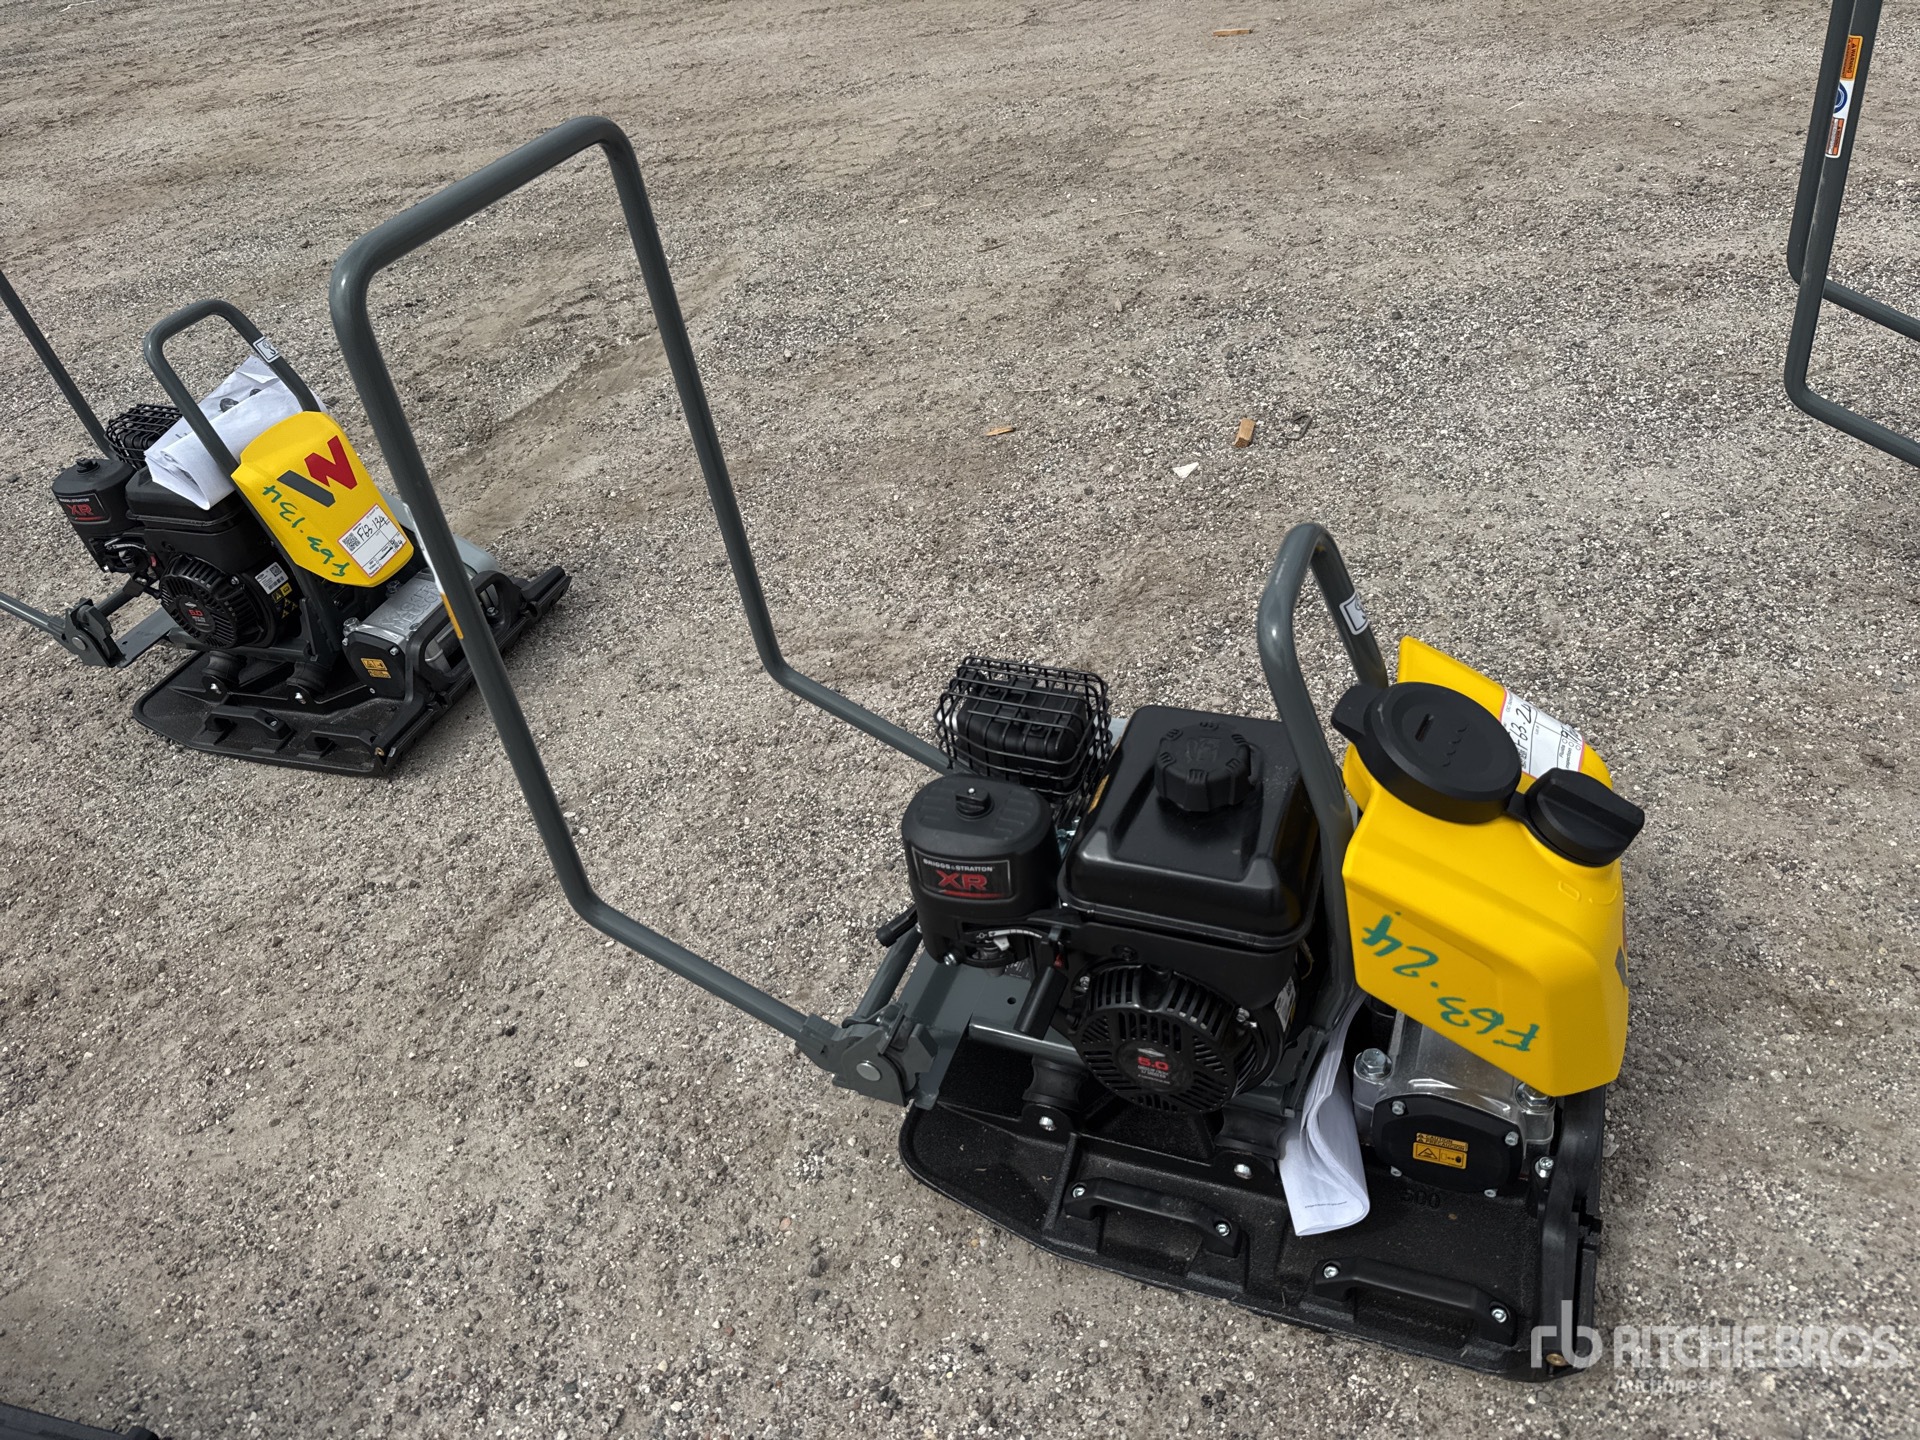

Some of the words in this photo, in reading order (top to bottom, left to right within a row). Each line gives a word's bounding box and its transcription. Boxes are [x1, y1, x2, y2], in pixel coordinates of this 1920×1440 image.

[66, 503, 95, 516] XR
[936, 869, 988, 890] XR
[1361, 914, 1540, 1052] F63.24
[1137, 1056, 1169, 1072] 5.0
